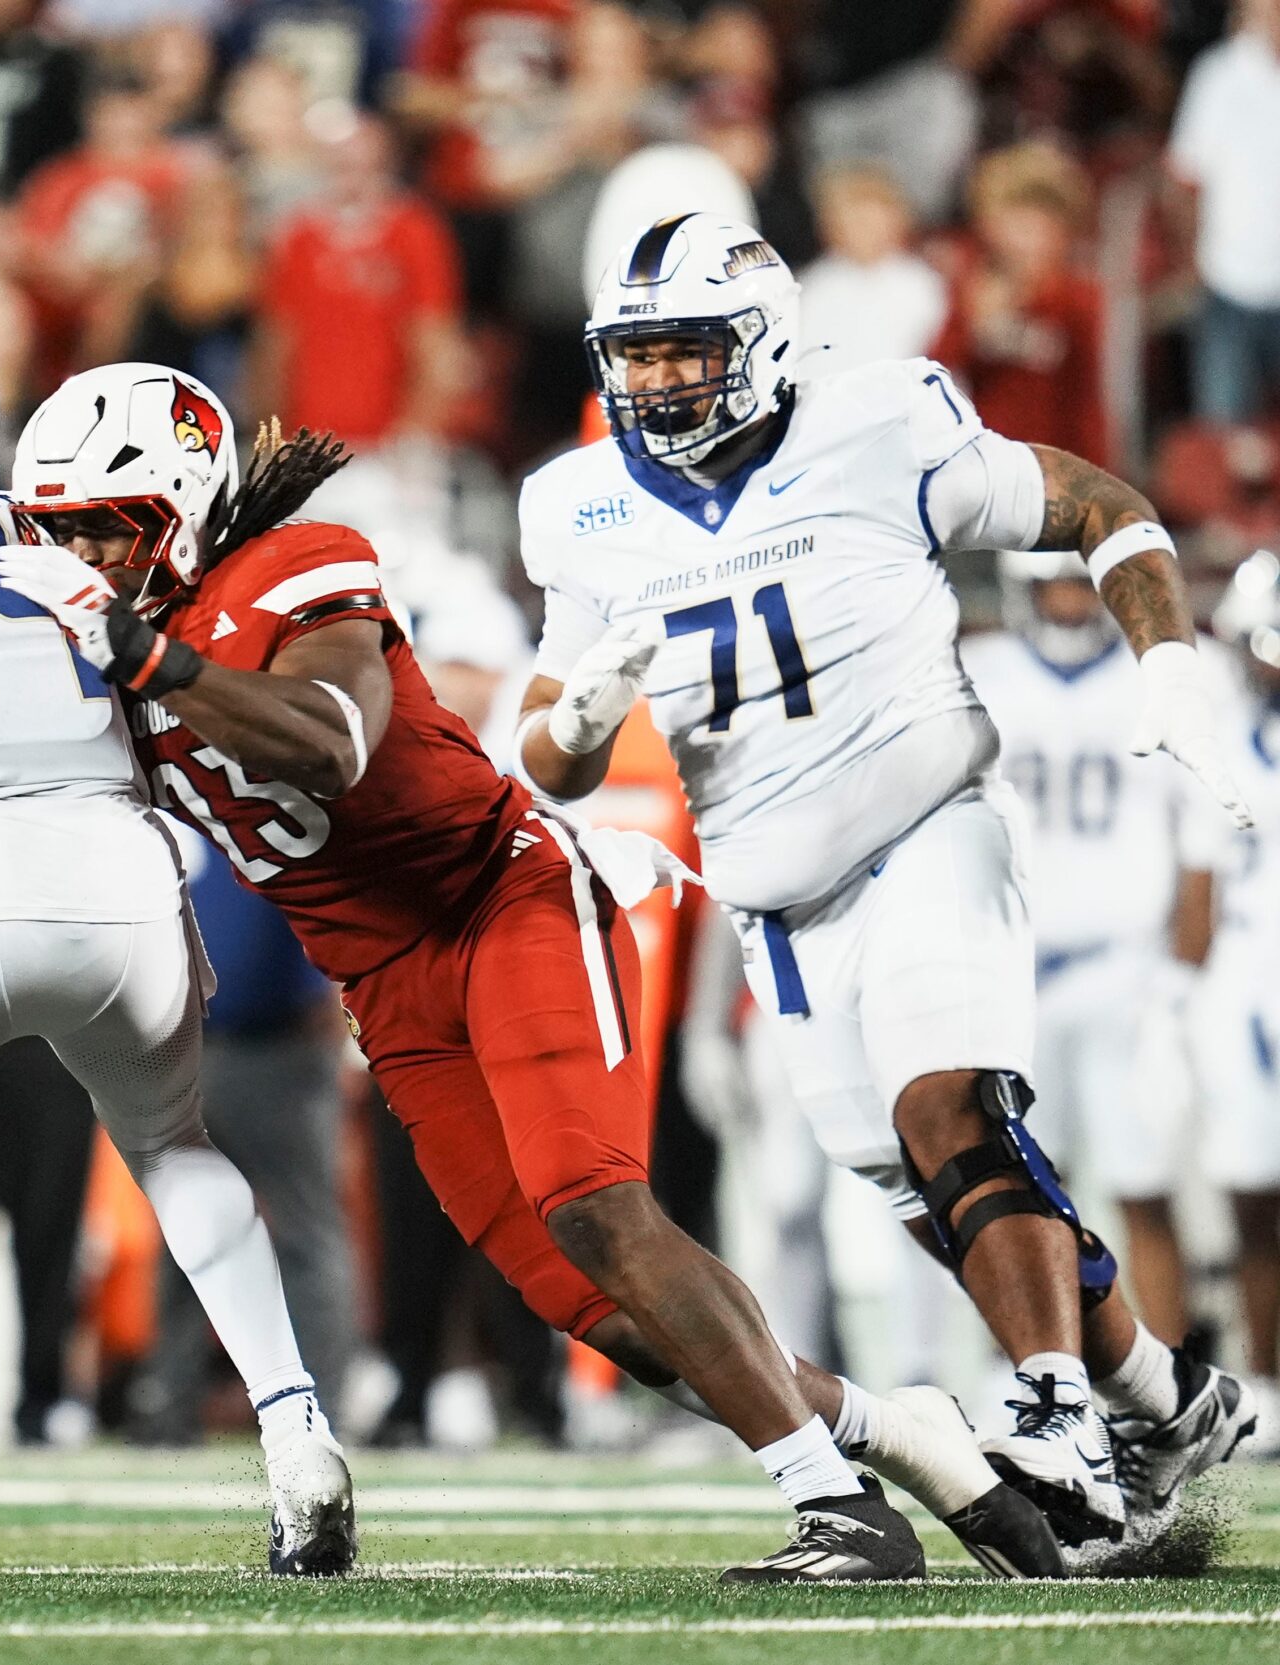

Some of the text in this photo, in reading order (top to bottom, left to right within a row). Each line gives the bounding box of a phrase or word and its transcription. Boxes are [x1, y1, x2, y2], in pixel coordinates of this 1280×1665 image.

[572, 491, 635, 536] SBC
[638, 535, 815, 602] JAMES MADISON
[661, 580, 816, 734] 71
